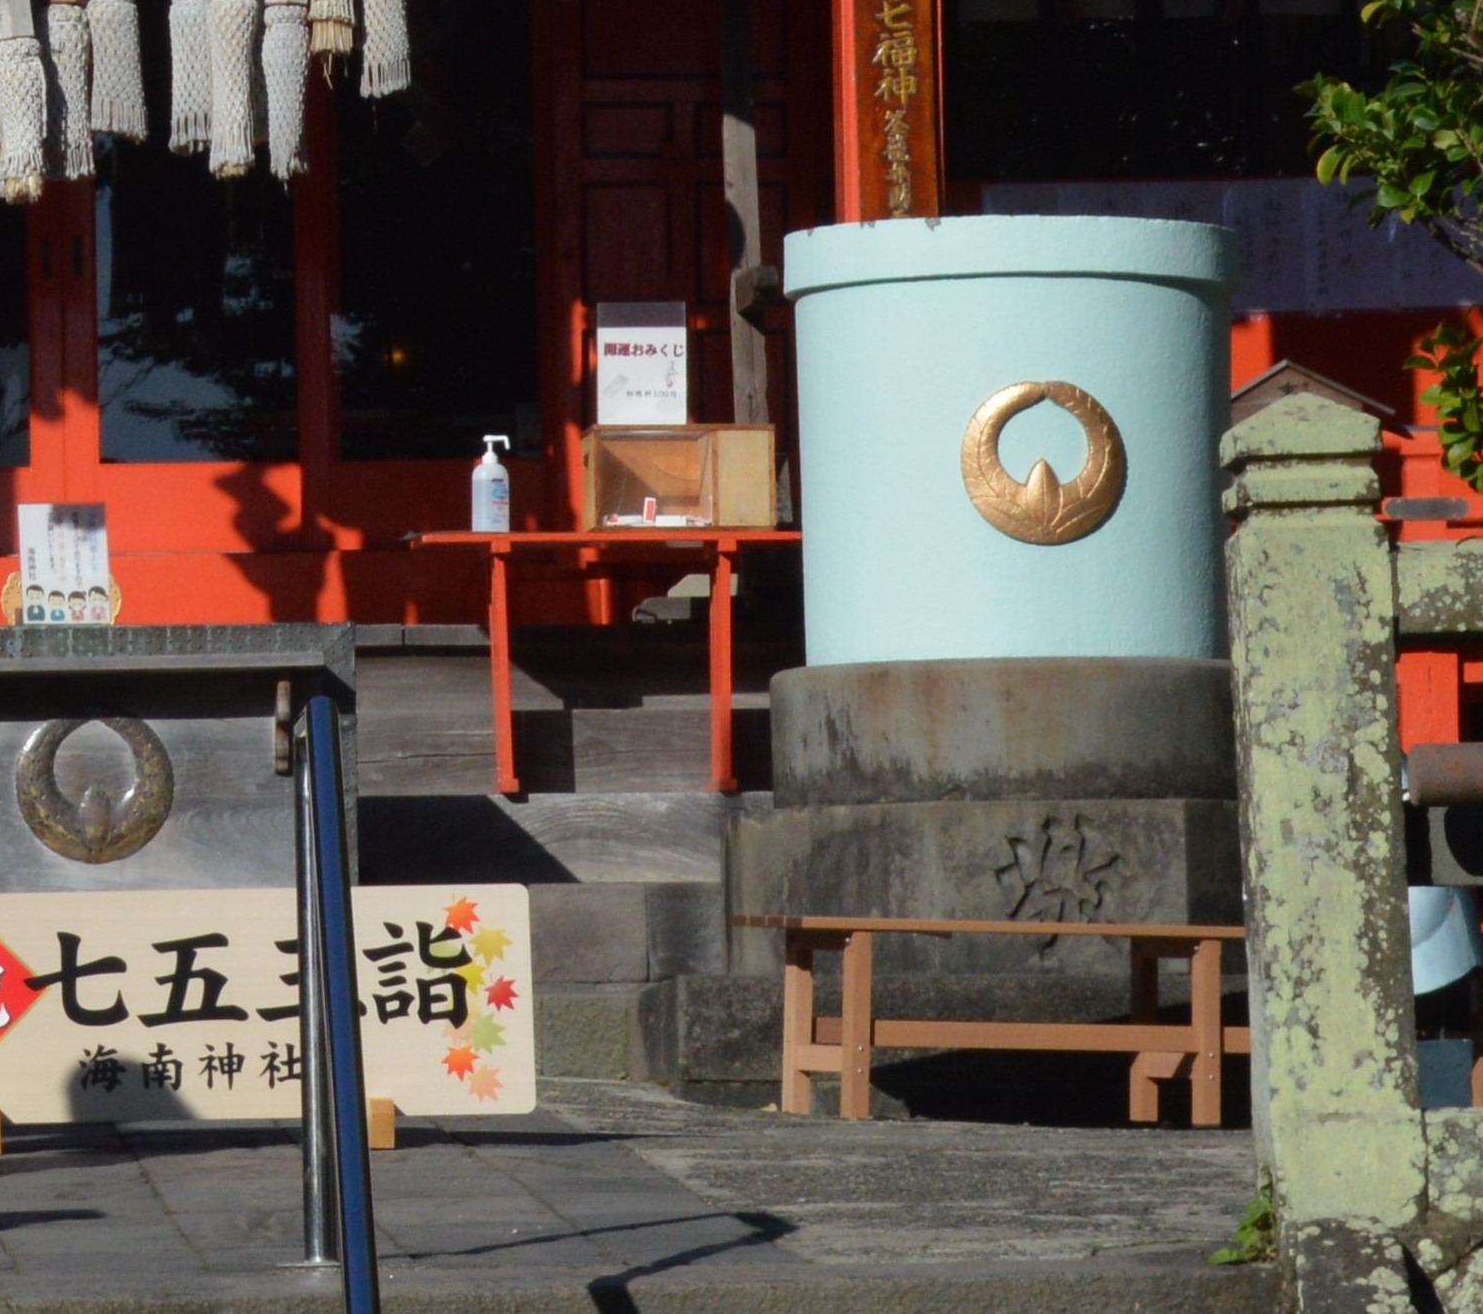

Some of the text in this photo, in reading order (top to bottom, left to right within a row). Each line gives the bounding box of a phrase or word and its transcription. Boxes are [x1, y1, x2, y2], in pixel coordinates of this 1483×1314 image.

[603, 342, 685, 358] 開運おみくじ
[79, 1043, 303, 1093] 海南神社
